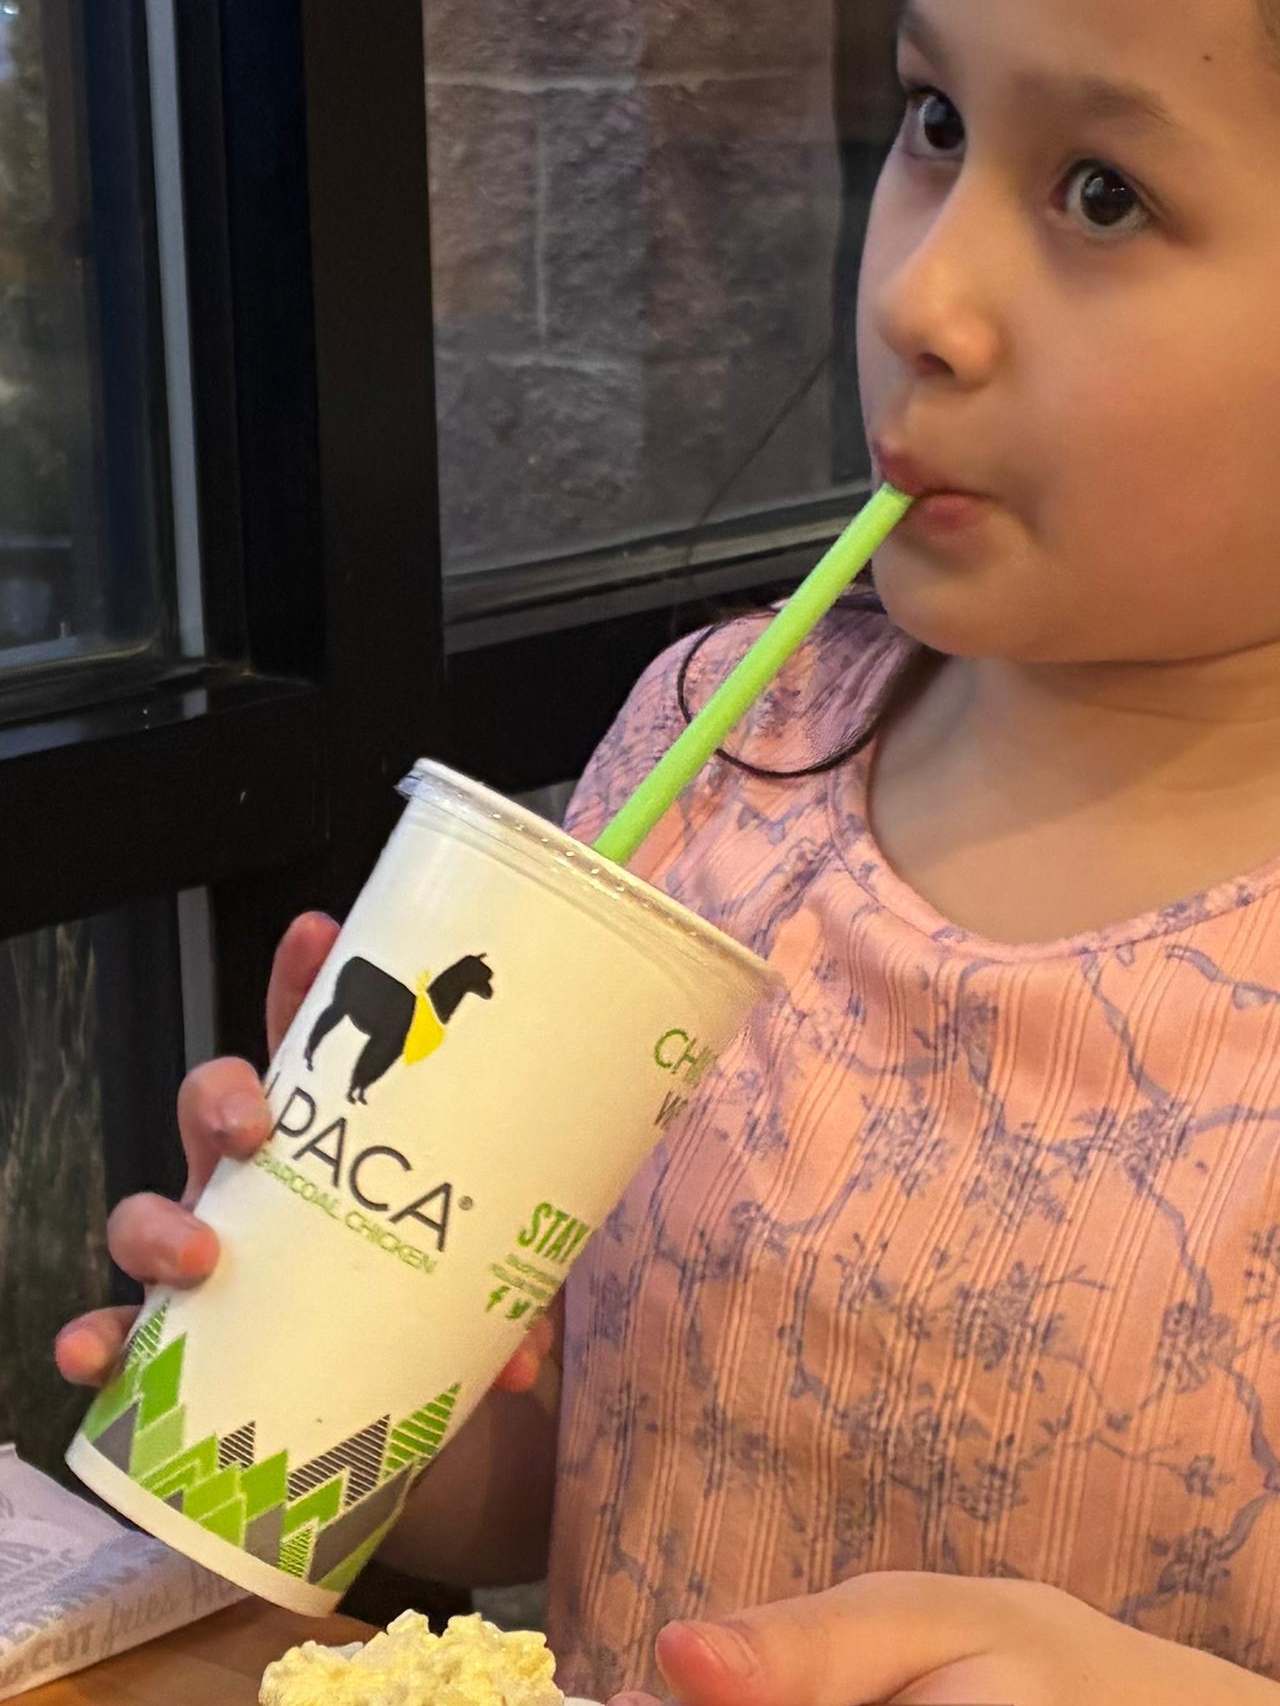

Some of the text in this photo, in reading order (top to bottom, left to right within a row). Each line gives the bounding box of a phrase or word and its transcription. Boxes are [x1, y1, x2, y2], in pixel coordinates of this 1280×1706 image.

[256, 1149, 439, 1275] HARCOAL CHICKEN
[265, 1071, 454, 1253] PACA
[31, 1623, 95, 1674] CUT
